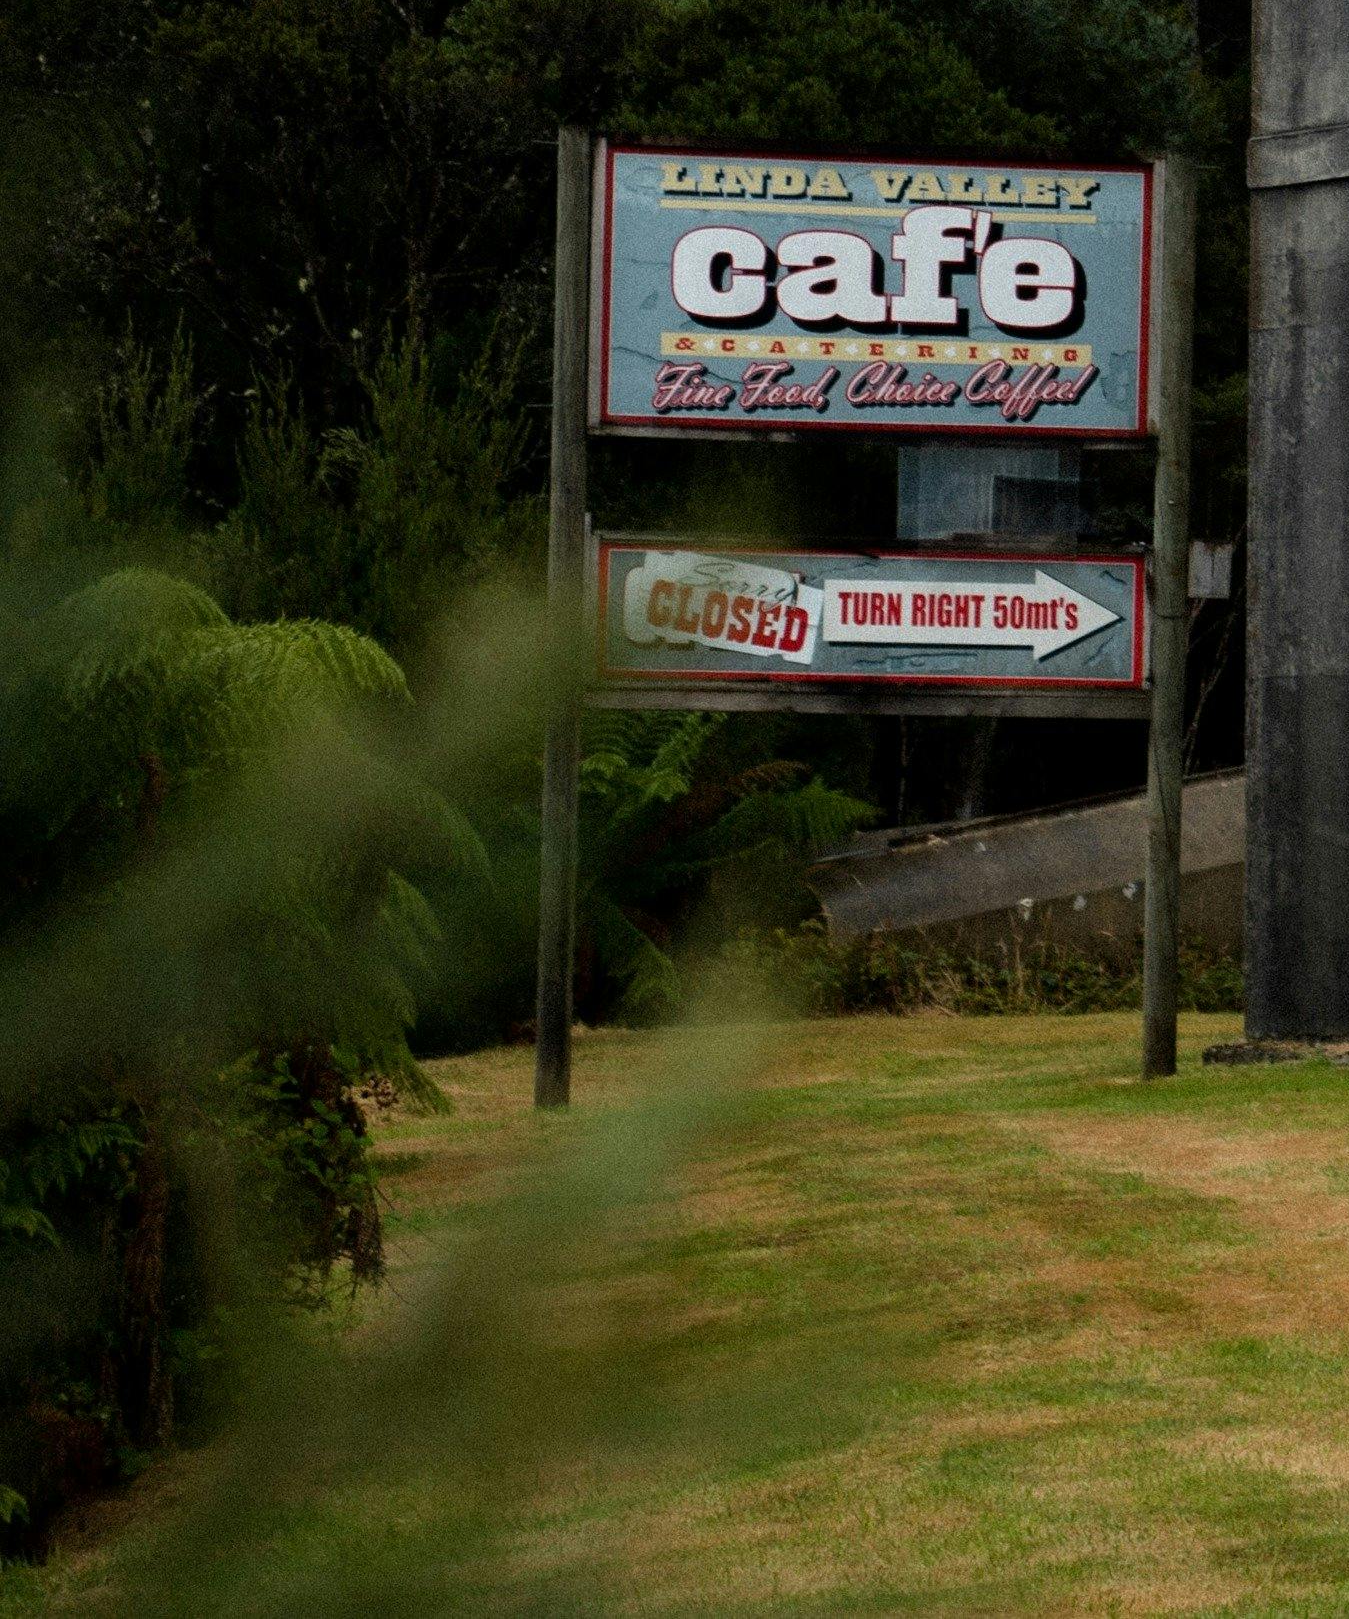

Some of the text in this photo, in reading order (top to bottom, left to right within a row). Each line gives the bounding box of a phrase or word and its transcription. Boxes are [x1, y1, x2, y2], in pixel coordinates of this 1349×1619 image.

[661, 160, 1101, 209] LINDA VALLEY
[674, 336, 697, 352] &
[653, 360, 1099, 423] Fine Food, Choice Coffee!
[647, 579, 809, 653] CLOSED
[838, 591, 1079, 631] TURN RIGHT 50mt's
